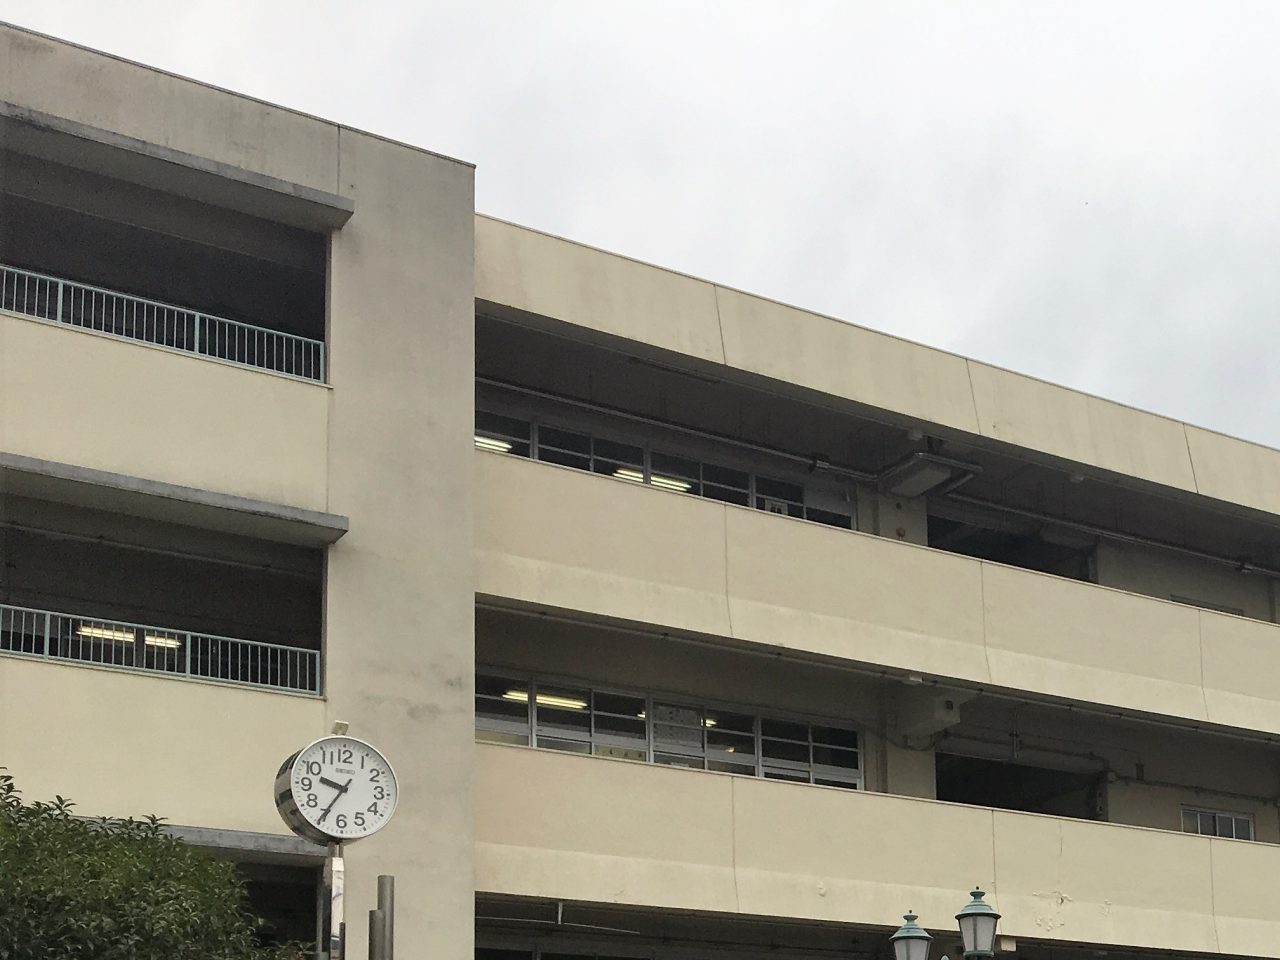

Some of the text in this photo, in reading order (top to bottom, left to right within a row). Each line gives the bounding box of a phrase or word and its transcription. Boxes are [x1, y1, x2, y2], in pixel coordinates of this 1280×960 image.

[322, 750, 333, 765] 11
[338, 749, 353, 764] 12
[306, 761, 321, 776] 10
[369, 768, 380, 782] 2
[300, 777, 312, 791] 9
[373, 786, 384, 800] 3
[306, 793, 318, 808] 8
[367, 802, 379, 815] 4
[336, 814, 347, 828] 6
[354, 812, 365, 826] 5
